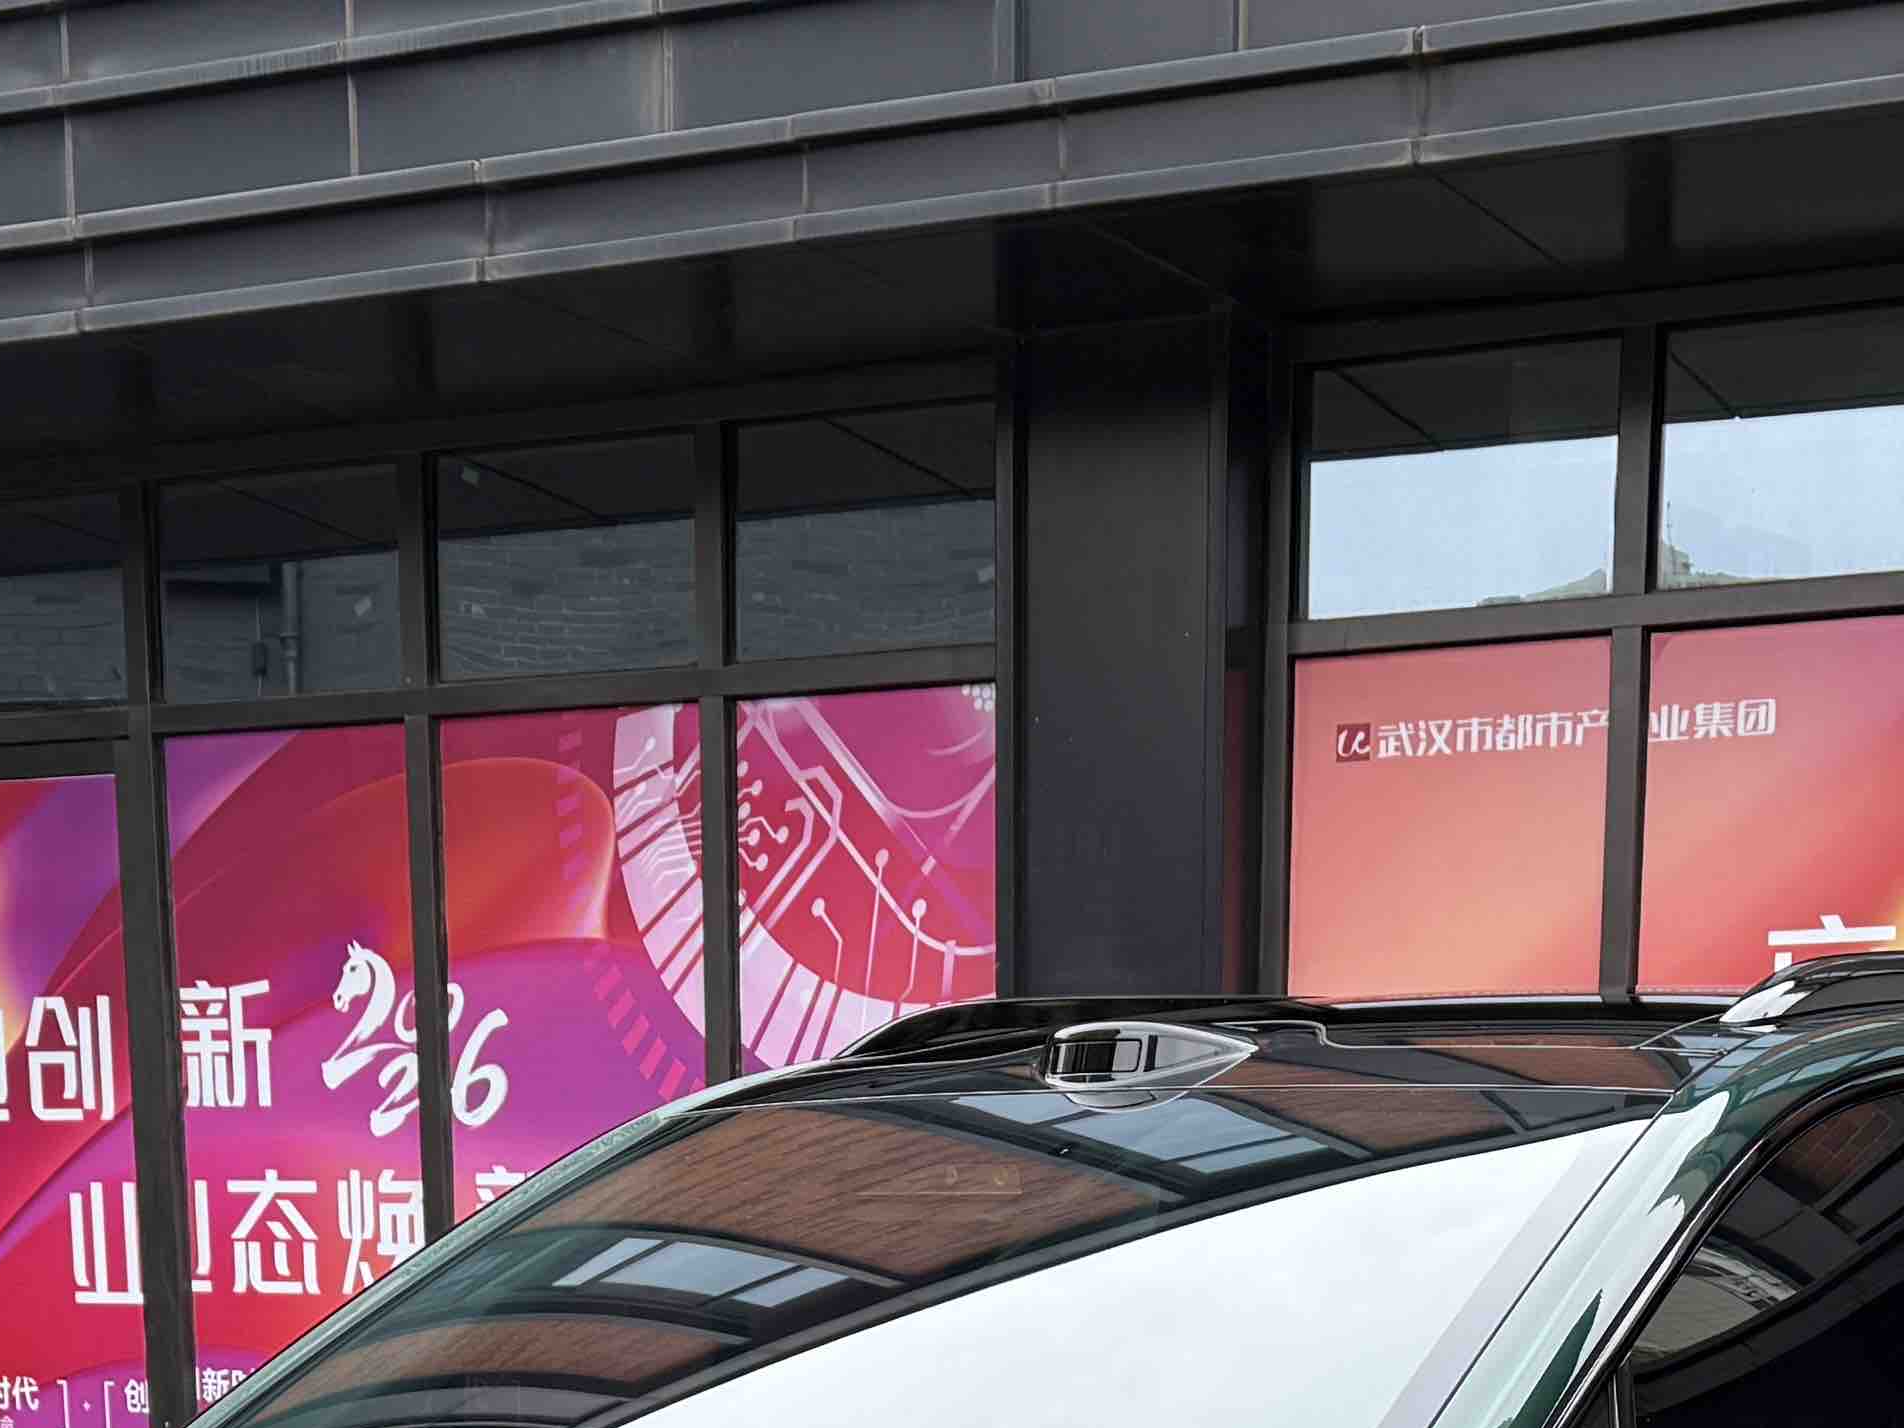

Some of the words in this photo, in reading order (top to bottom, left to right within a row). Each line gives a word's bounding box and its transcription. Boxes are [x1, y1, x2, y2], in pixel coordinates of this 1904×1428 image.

[1377, 698, 1776, 759] 武汉市都市产业集团
[69, 1165, 531, 1305] 业态焕
